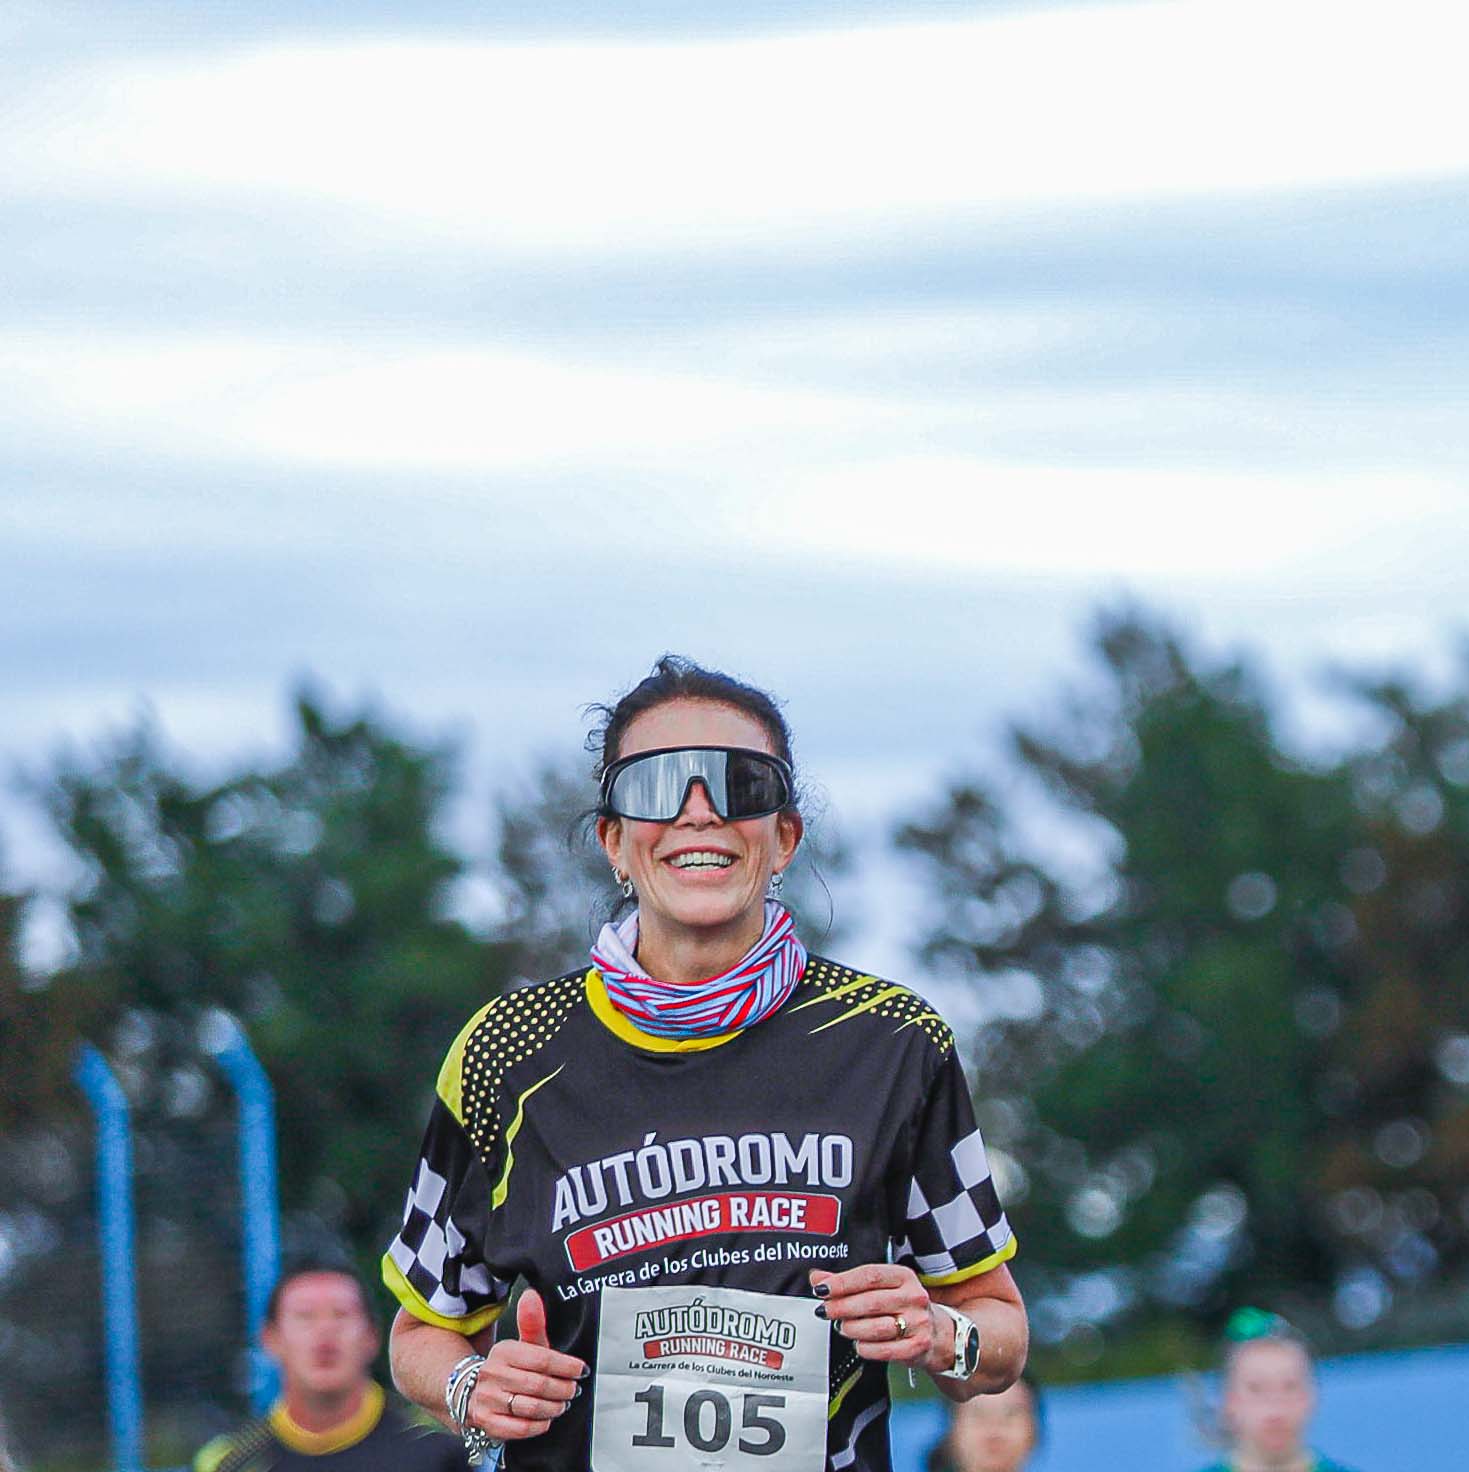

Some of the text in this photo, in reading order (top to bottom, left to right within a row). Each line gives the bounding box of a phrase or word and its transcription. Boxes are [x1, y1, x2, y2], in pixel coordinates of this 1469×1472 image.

[551, 1131, 853, 1233] AUTÓDROMO
[593, 1196, 808, 1259] RUNNING RACE
[557, 1241, 849, 1302] La Carrera de los Clubes del Noroeste
[634, 1296, 797, 1351] AUTÓDROMO
[659, 1338, 768, 1366] RUNNING RACE
[629, 1361, 794, 1382] La Carrera de los Clubes del Noroeste
[632, 1384, 787, 1456] 105
